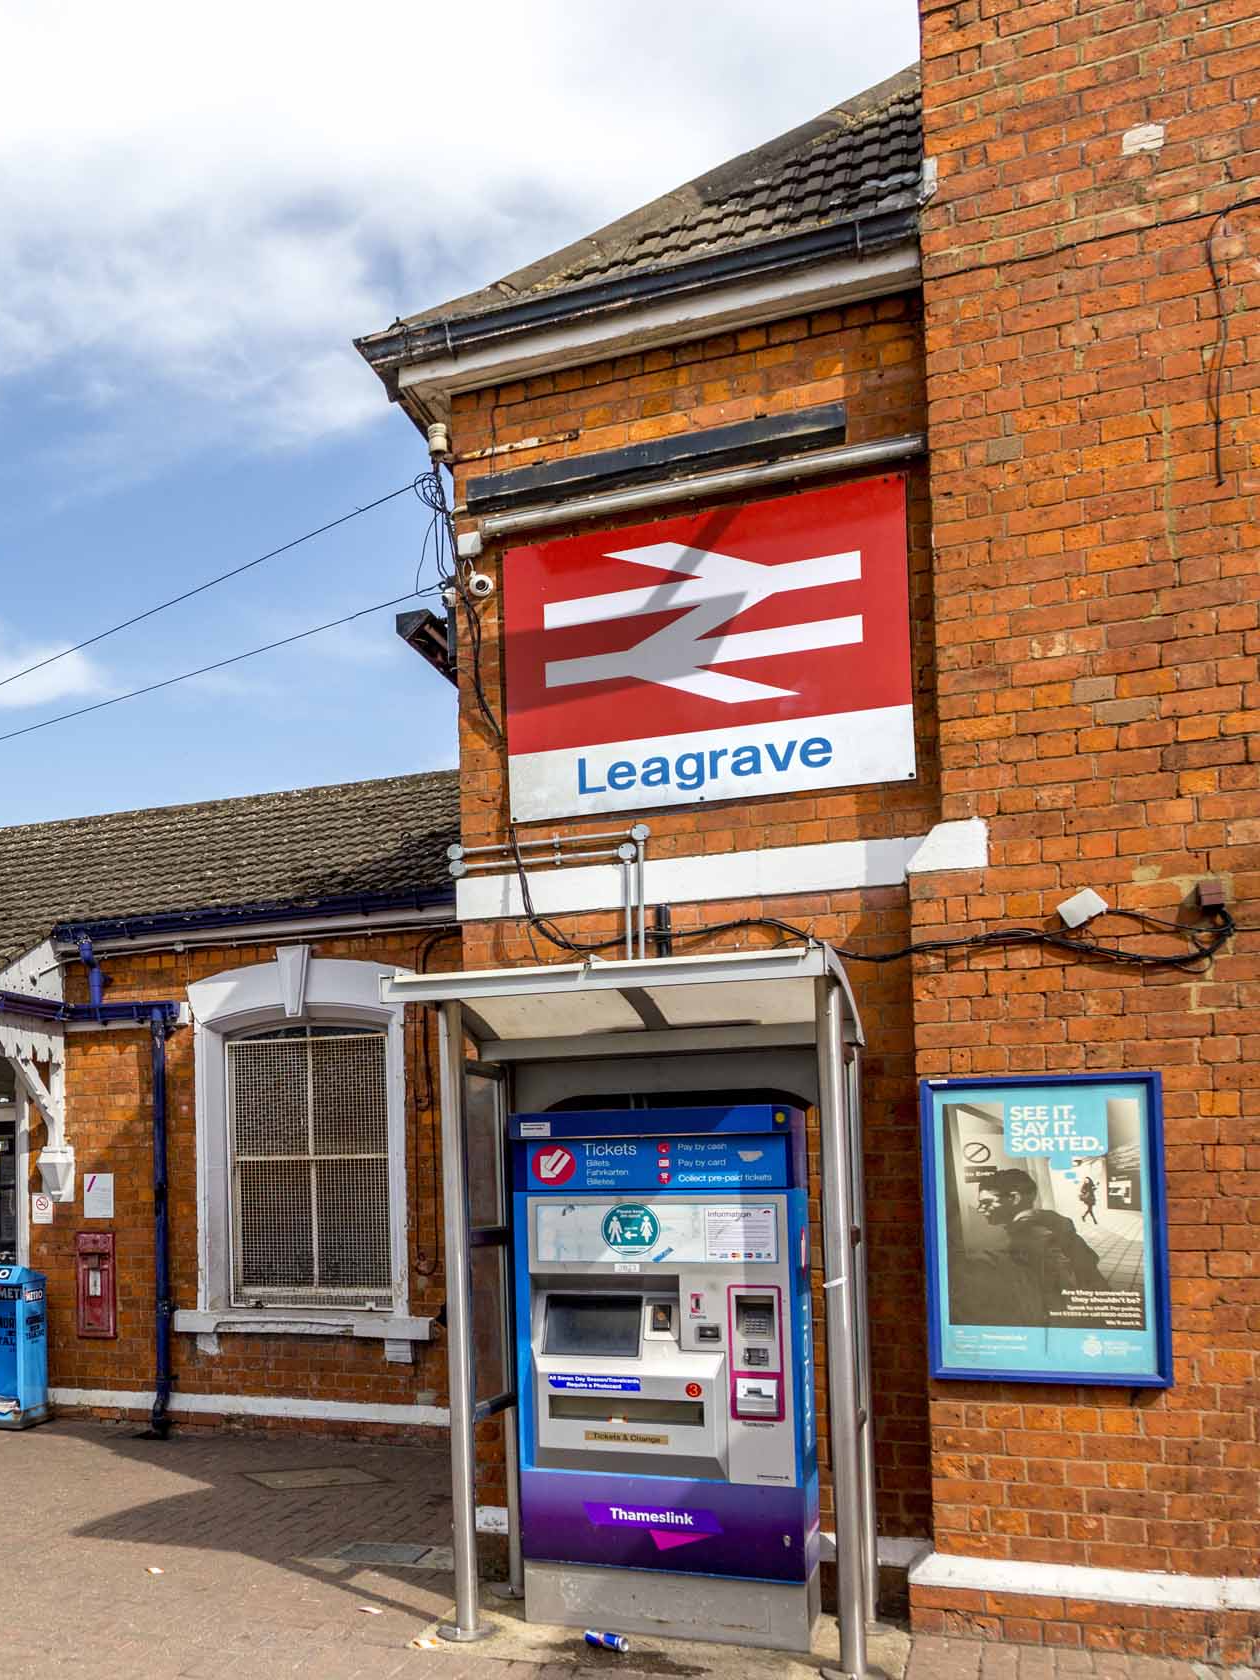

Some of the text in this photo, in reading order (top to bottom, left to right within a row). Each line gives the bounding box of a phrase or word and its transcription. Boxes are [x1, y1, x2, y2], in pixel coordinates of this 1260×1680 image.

[577, 737, 833, 795] Leagrave
[1010, 1104, 1077, 1120] SEE IT.
[1010, 1121, 1077, 1136] SAY IT.
[582, 1143, 637, 1156] Tickets
[677, 1143, 693, 1152] Pay
[695, 1143, 705, 1152] by
[1011, 1136, 1104, 1152] SORTED.
[586, 1159, 611, 1167] Billets
[678, 1158, 727, 1168] Pay by card
[586, 1168, 629, 1176] Fahrkarten
[678, 1173, 772, 1183] Collect pre-paid tickets
[707, 1210, 752, 1218] Information
[24, 1290, 43, 1301] METRO
[1076, 1289, 1094, 1297] they
[1070, 1296, 1089, 1304] they
[688, 1385, 699, 1396] 3
[593, 1431, 621, 1442] Tickets
[630, 1434, 661, 1444] Change
[609, 1507, 694, 1526] Thameslink
